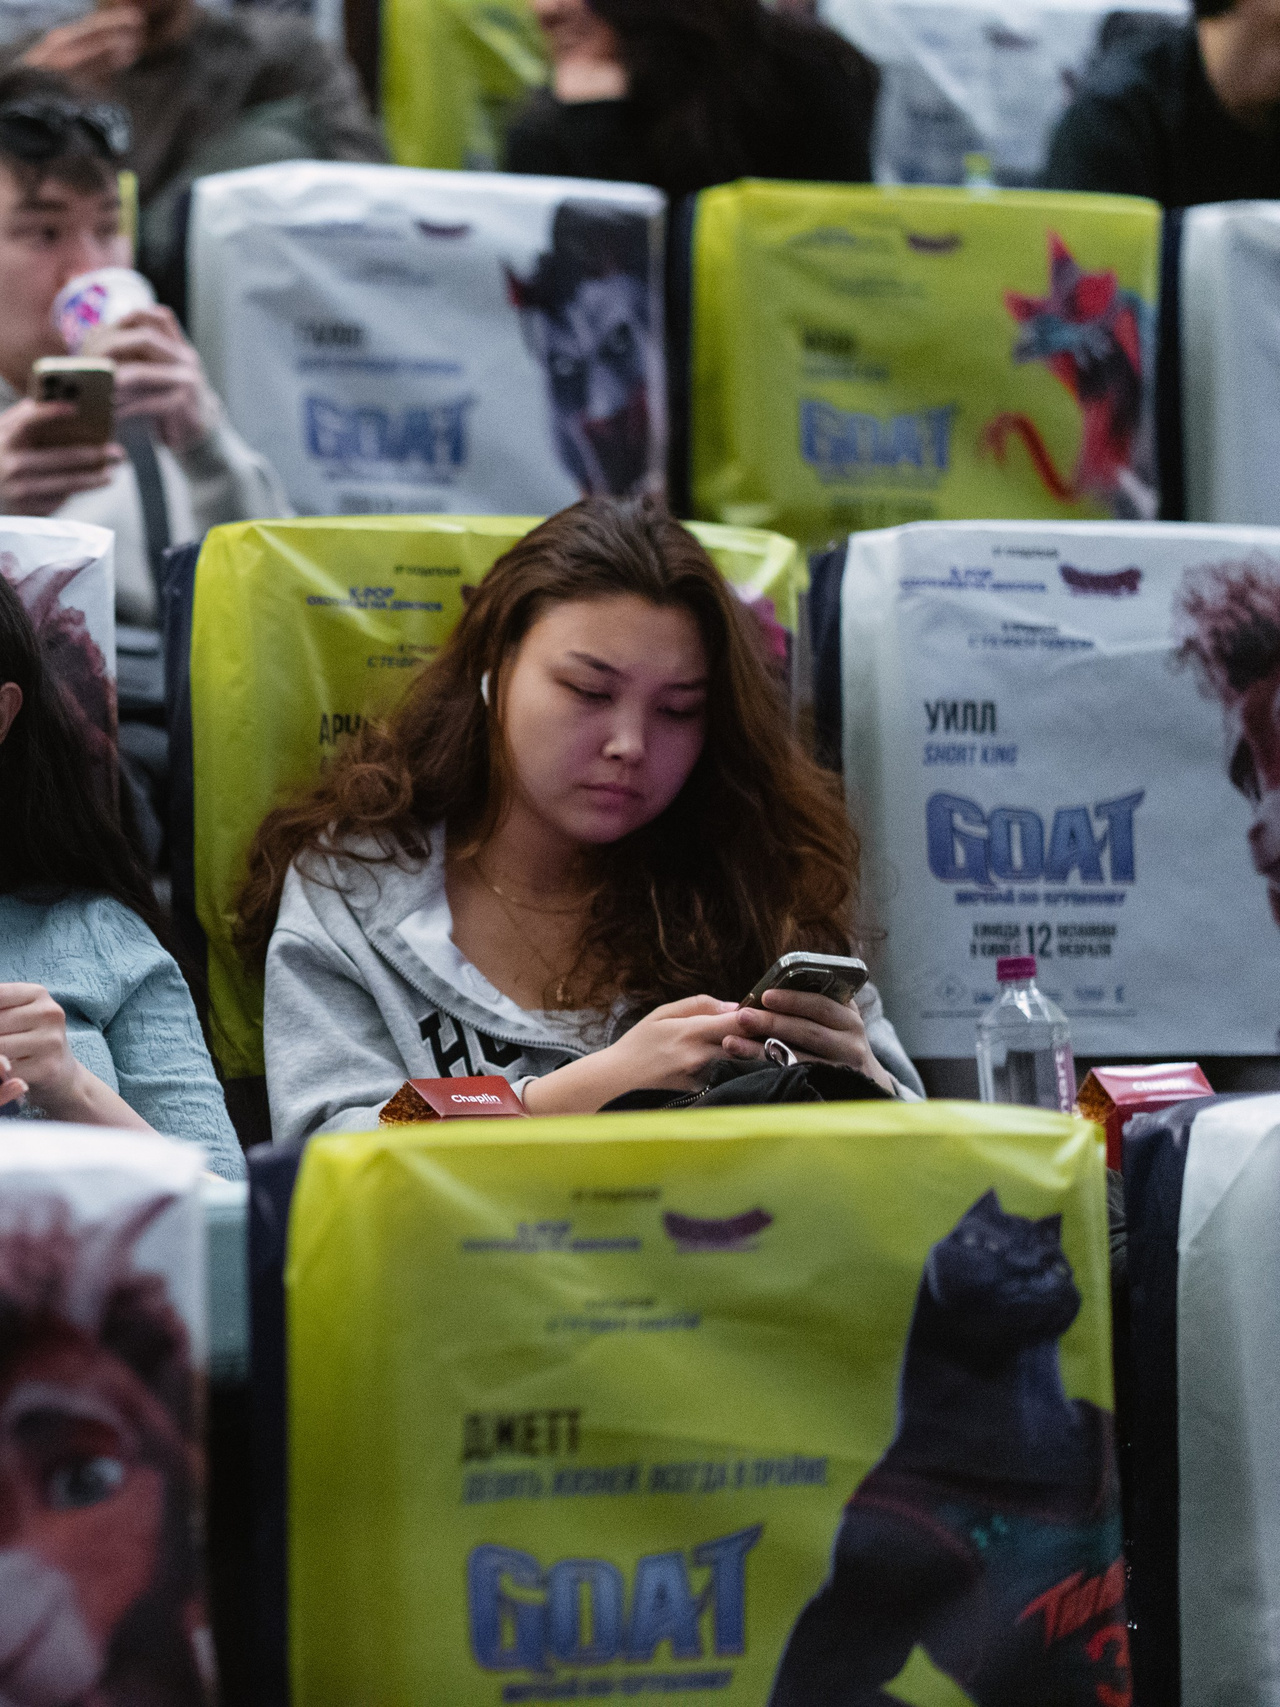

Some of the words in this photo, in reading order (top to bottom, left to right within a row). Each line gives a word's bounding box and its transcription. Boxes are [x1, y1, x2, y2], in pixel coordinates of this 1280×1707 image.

[925, 700, 996, 735] УИЛЛ
[926, 791, 1145, 889] GOAT
[1027, 922, 1052, 958] 12
[451, 1093, 501, 1105] Chaplin
[469, 1524, 763, 1680] GOAT
